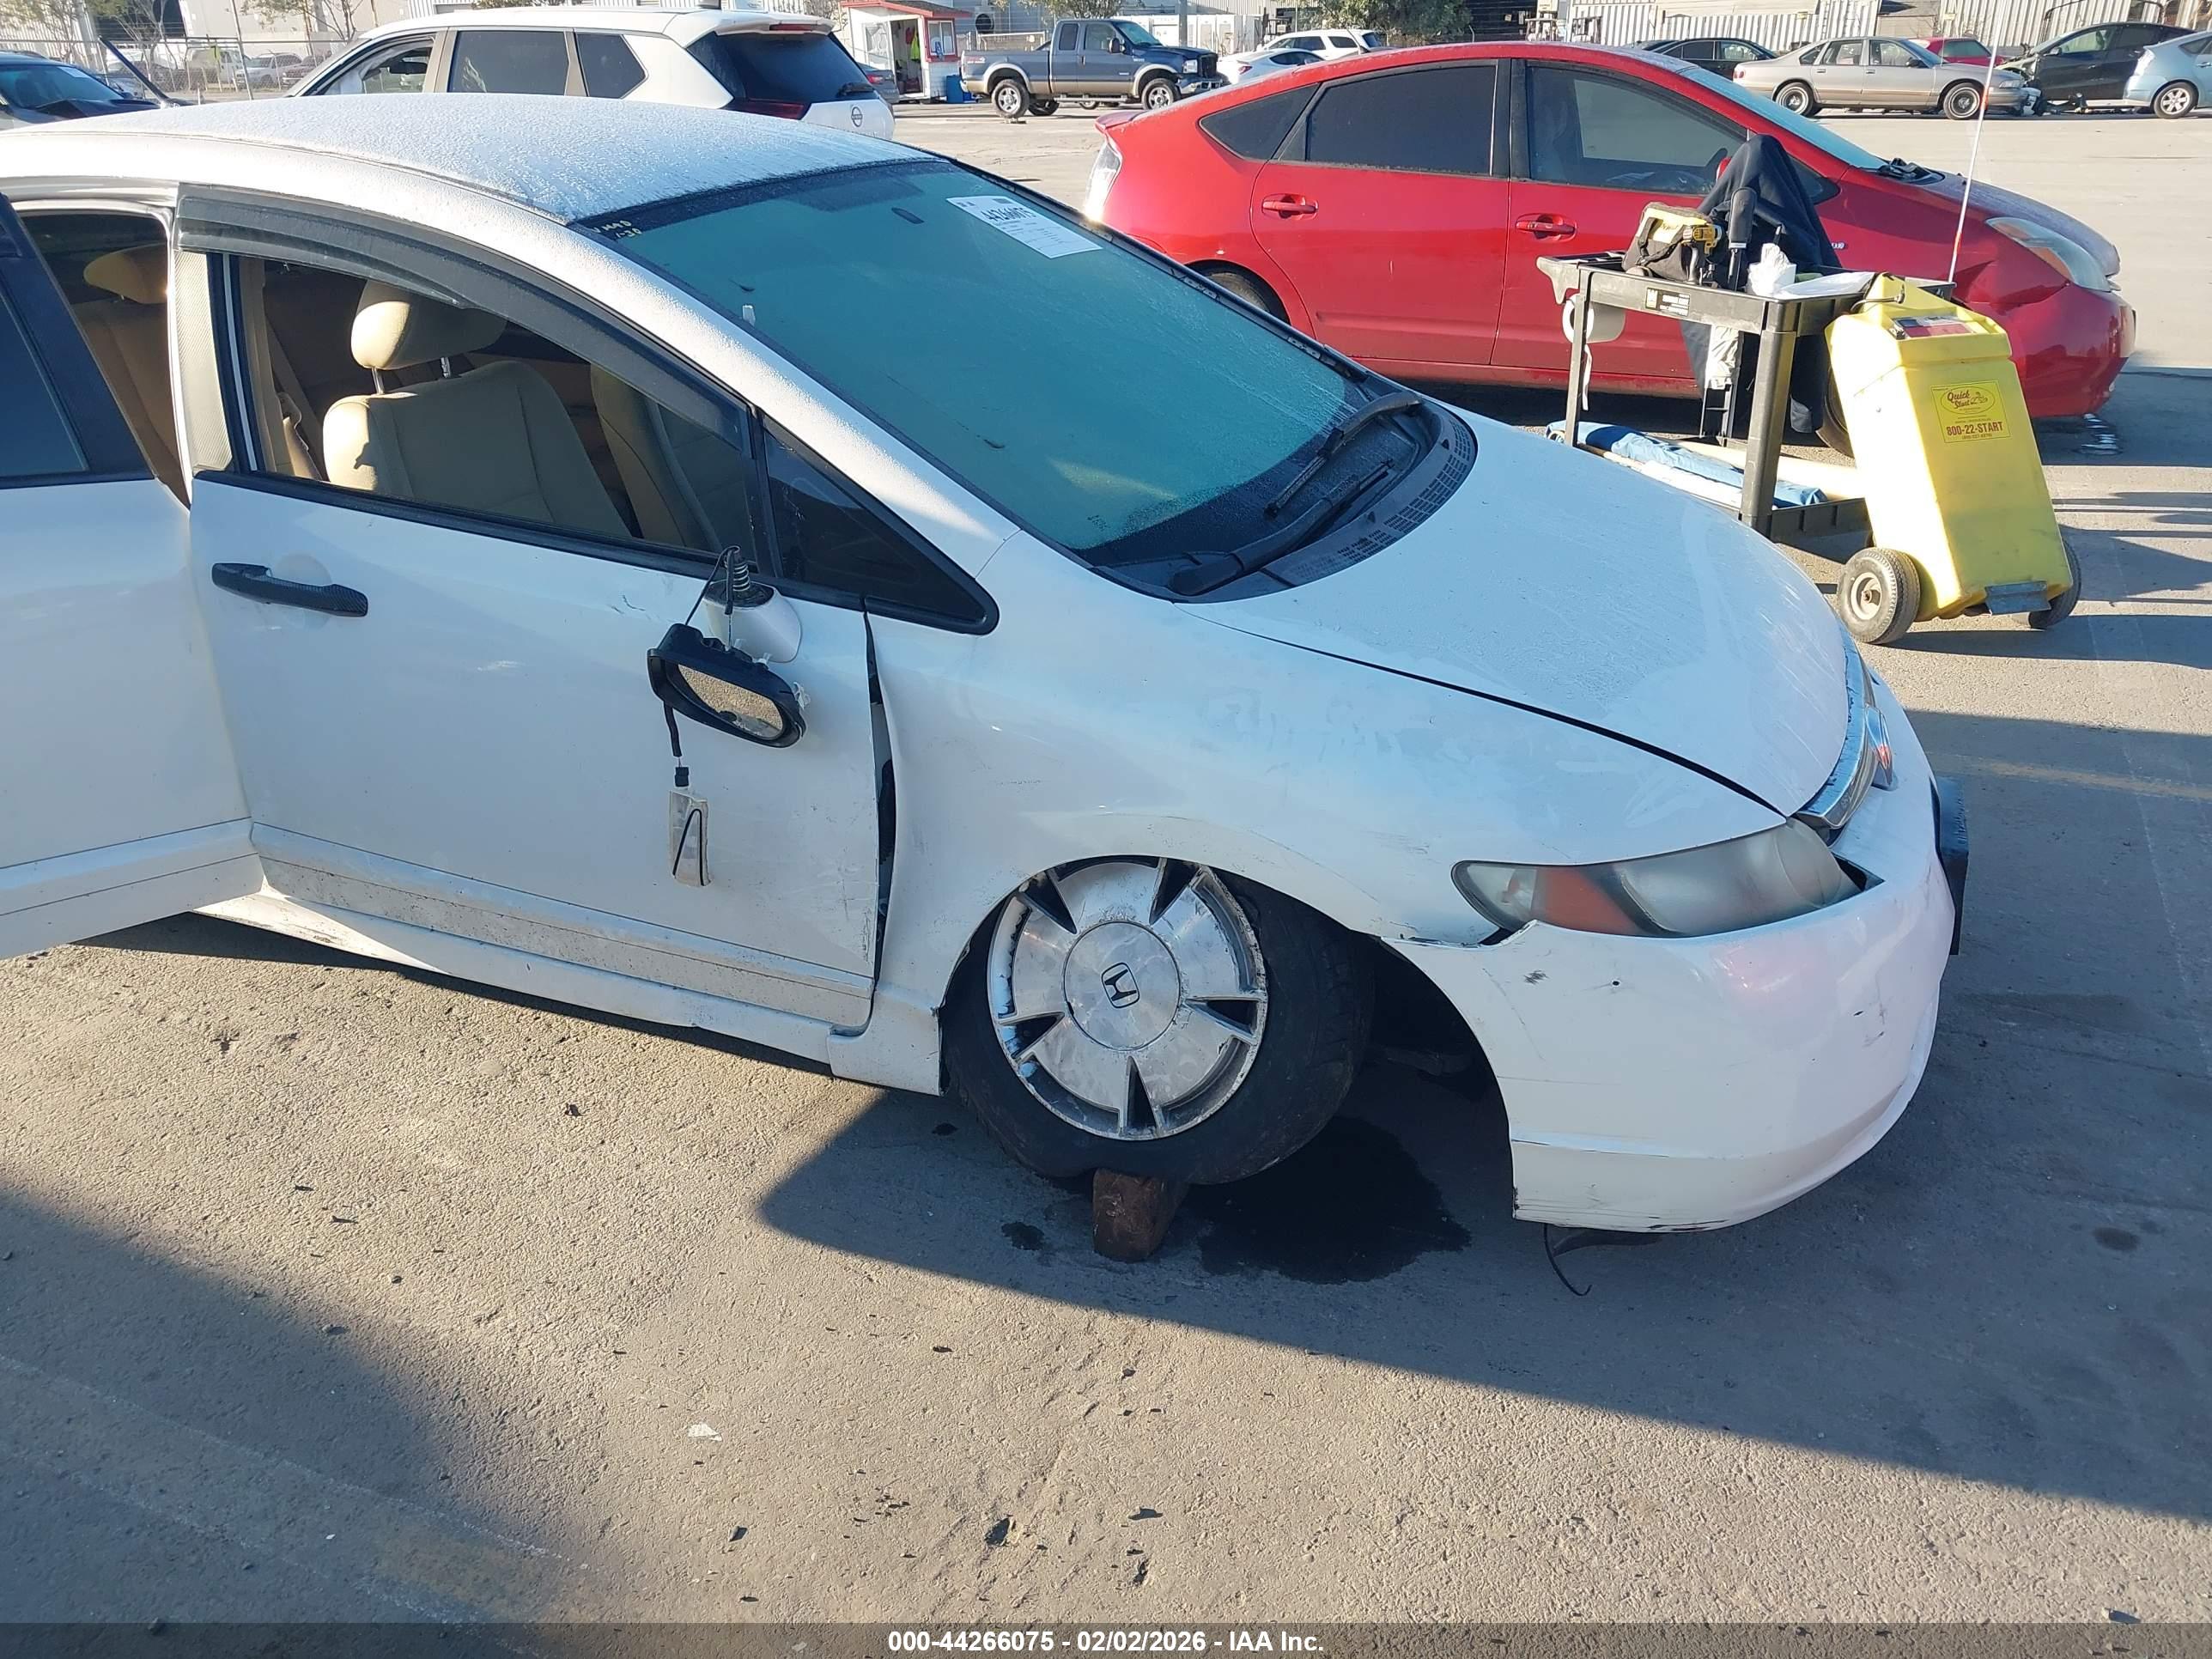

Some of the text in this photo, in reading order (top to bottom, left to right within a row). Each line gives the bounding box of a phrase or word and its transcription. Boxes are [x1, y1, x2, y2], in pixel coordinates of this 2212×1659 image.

[1947, 389, 1971, 404] Quick
[1954, 399, 1971, 410] Start
[1946, 421, 2003, 435] 800-22-START
